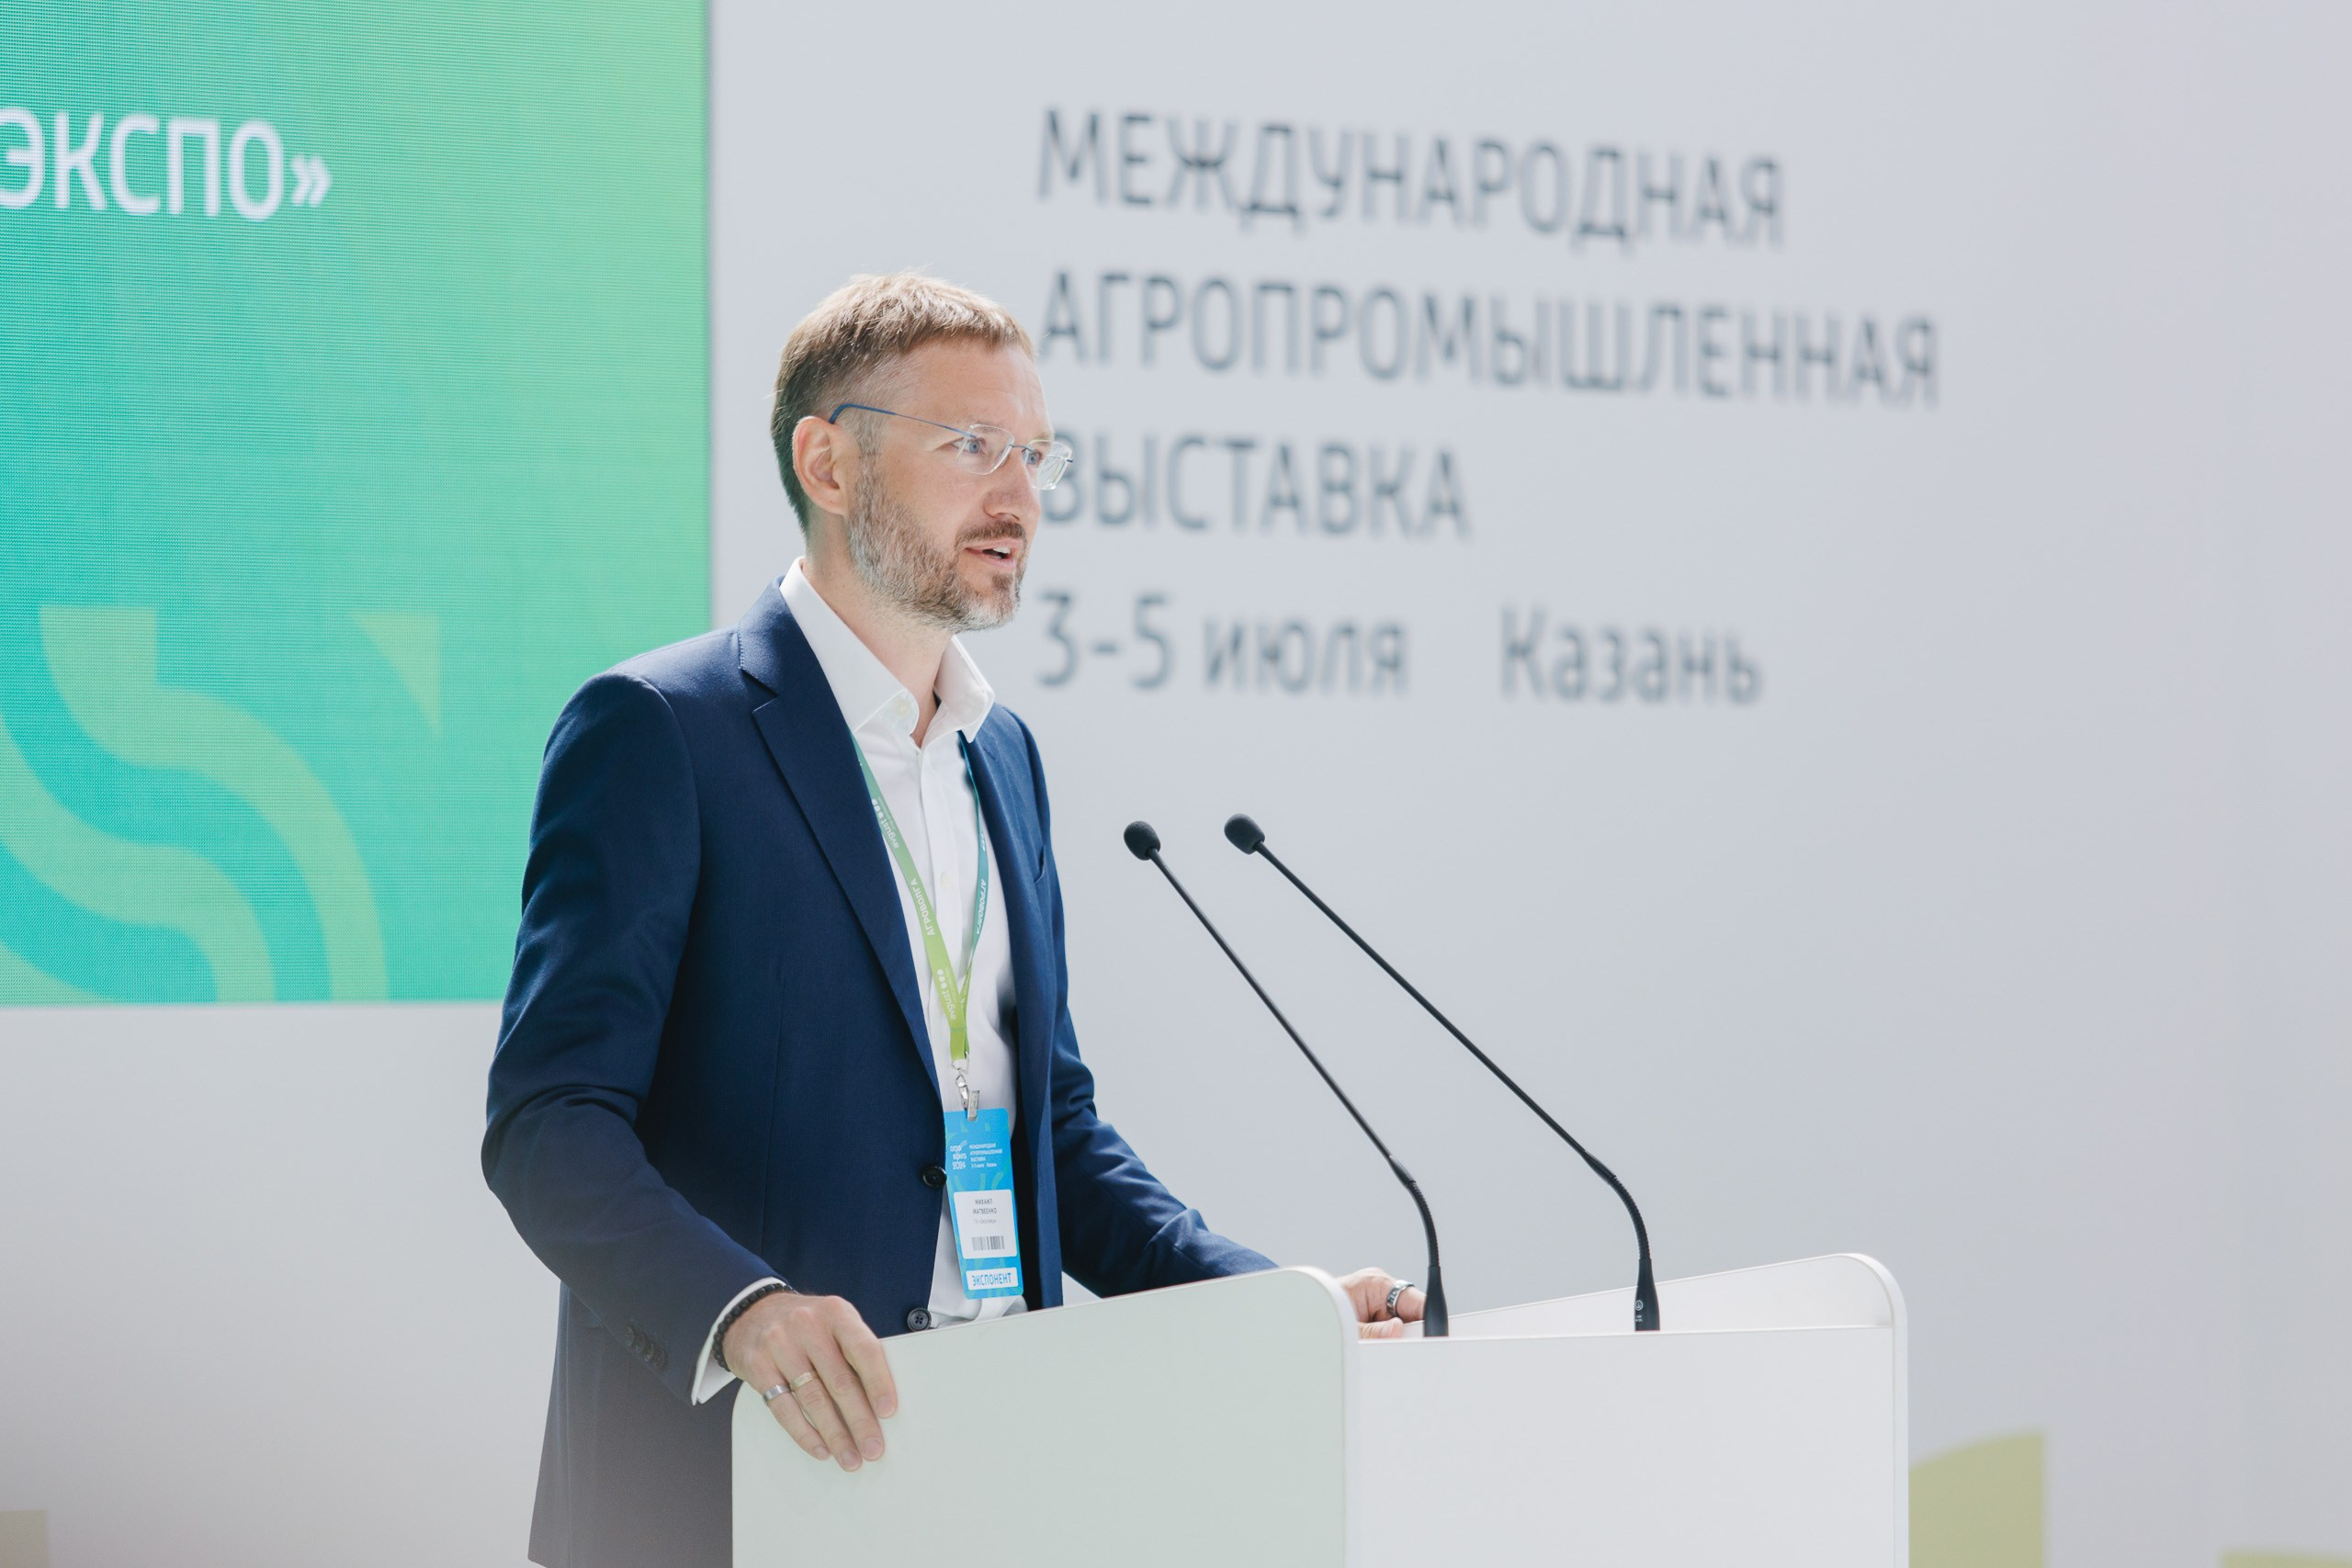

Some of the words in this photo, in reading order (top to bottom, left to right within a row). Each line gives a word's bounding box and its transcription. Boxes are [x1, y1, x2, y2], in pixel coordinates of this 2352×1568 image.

[0, 107, 332, 222] ЭКСПО»
[1038, 107, 1784, 248] МЕЖДУНАРОДНАЯ
[1039, 269, 1940, 407] АГРОПРОМЫШЛЕННАЯ
[1040, 431, 1471, 538] ВЫСТАВКА
[1203, 615, 1408, 694] июля
[1499, 604, 1764, 705] Казань
[910, 878, 935, 936] АГРОВОЛГА
[976, 878, 987, 935] АГРОВОЛГА
[971, 1272, 1012, 1286] ЭКСПОНЕНТ
